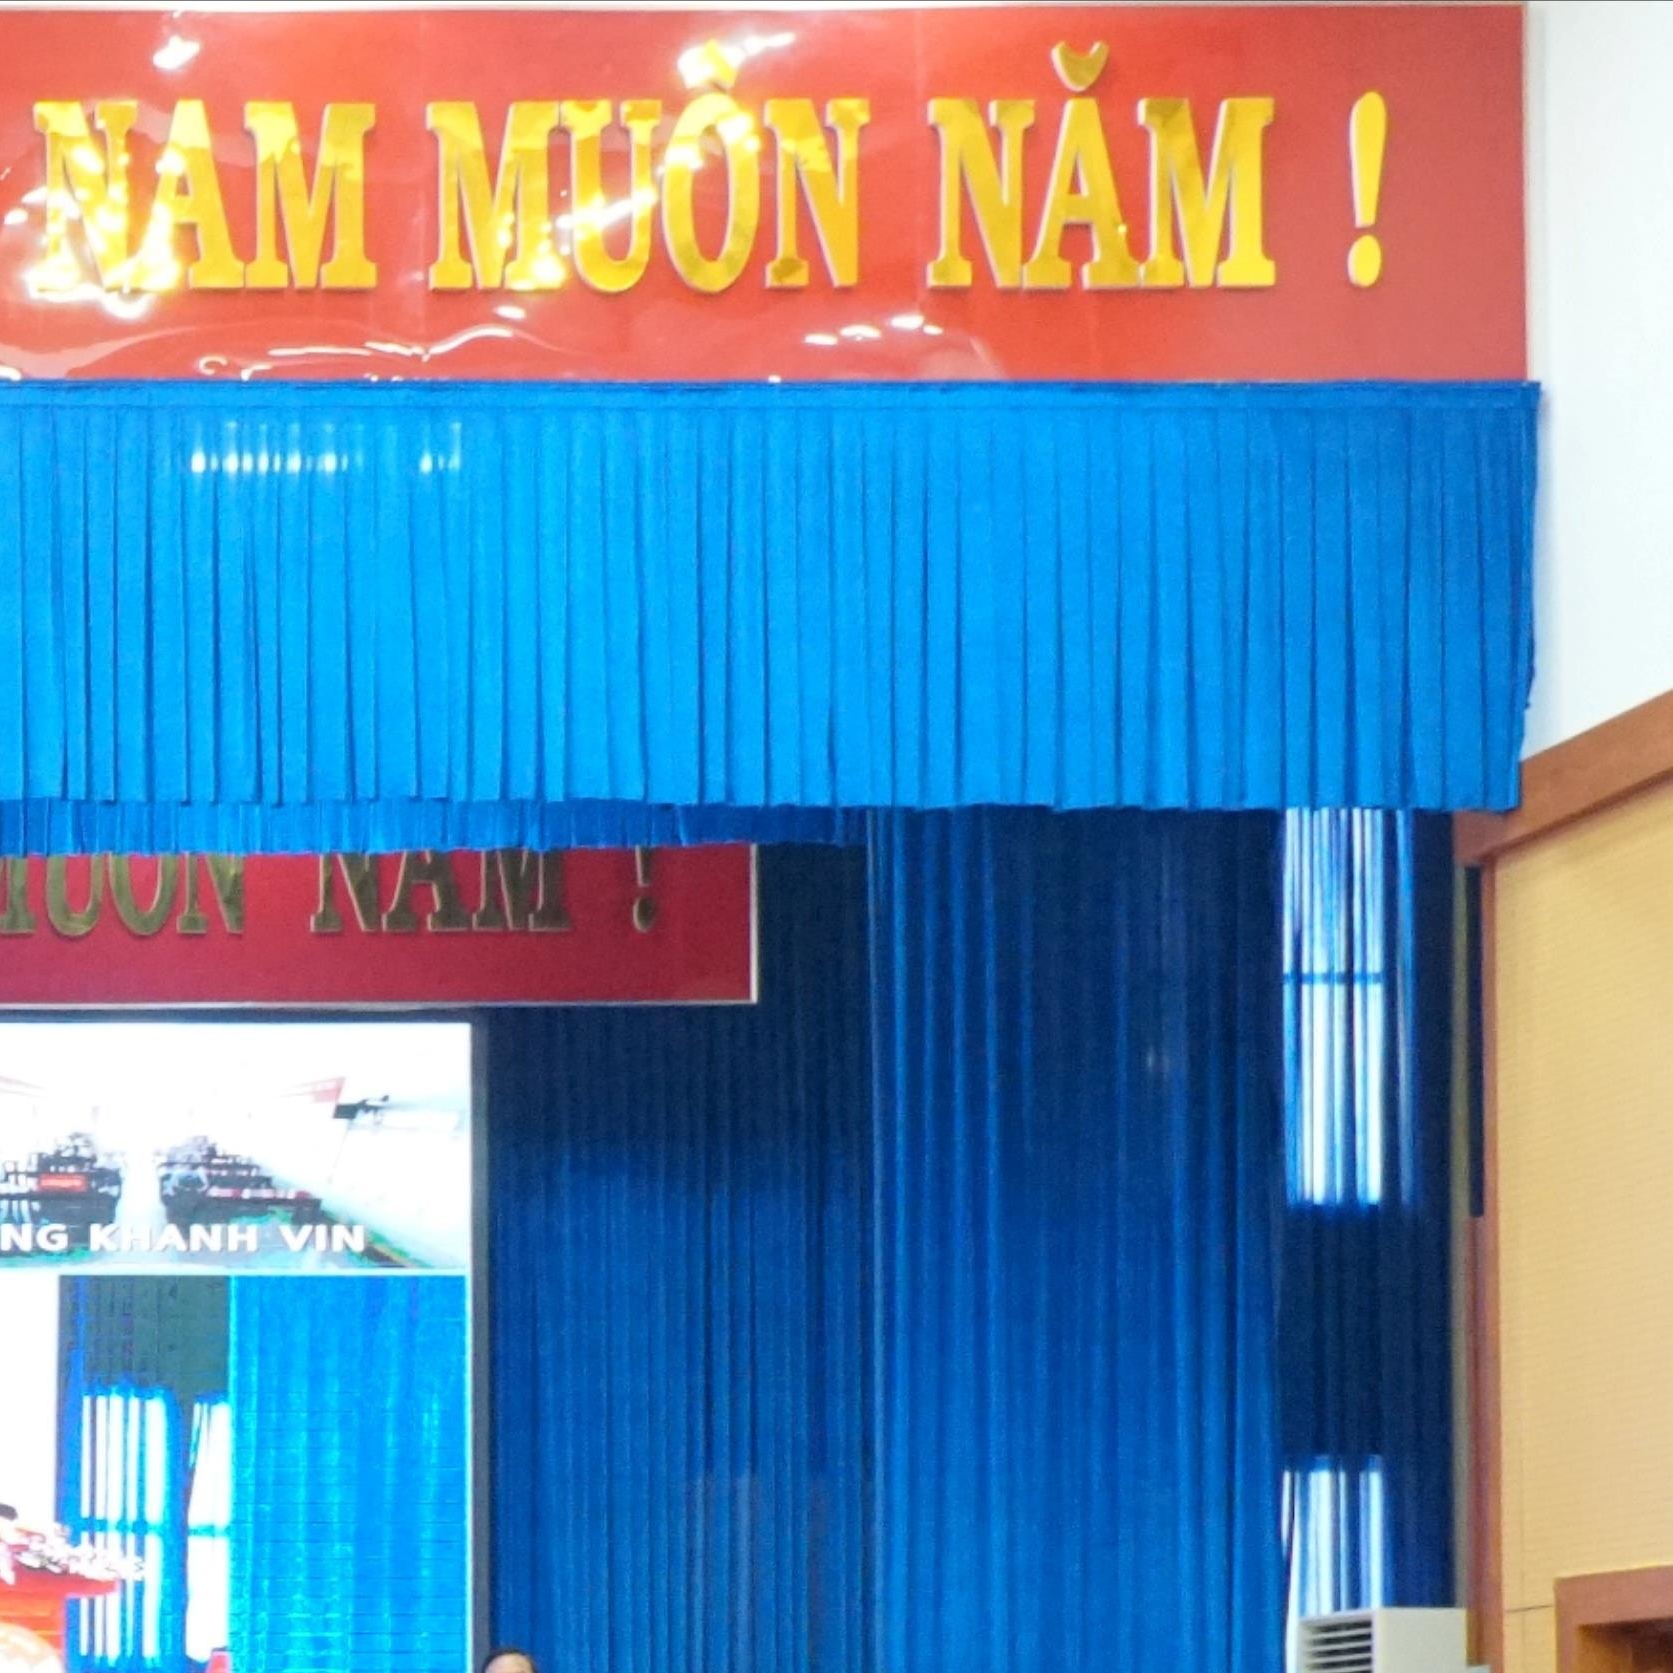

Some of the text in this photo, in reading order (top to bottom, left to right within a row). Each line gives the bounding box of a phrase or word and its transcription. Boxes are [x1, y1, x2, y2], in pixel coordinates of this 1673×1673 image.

[32, 98, 376, 296] NAM
[426, 40, 865, 297] MUÔN
[927, 40, 1276, 291] NĂM
[1346, 90, 1388, 288] !
[89, 1222, 257, 1252] KHANH
[280, 1223, 367, 1252] VIN
